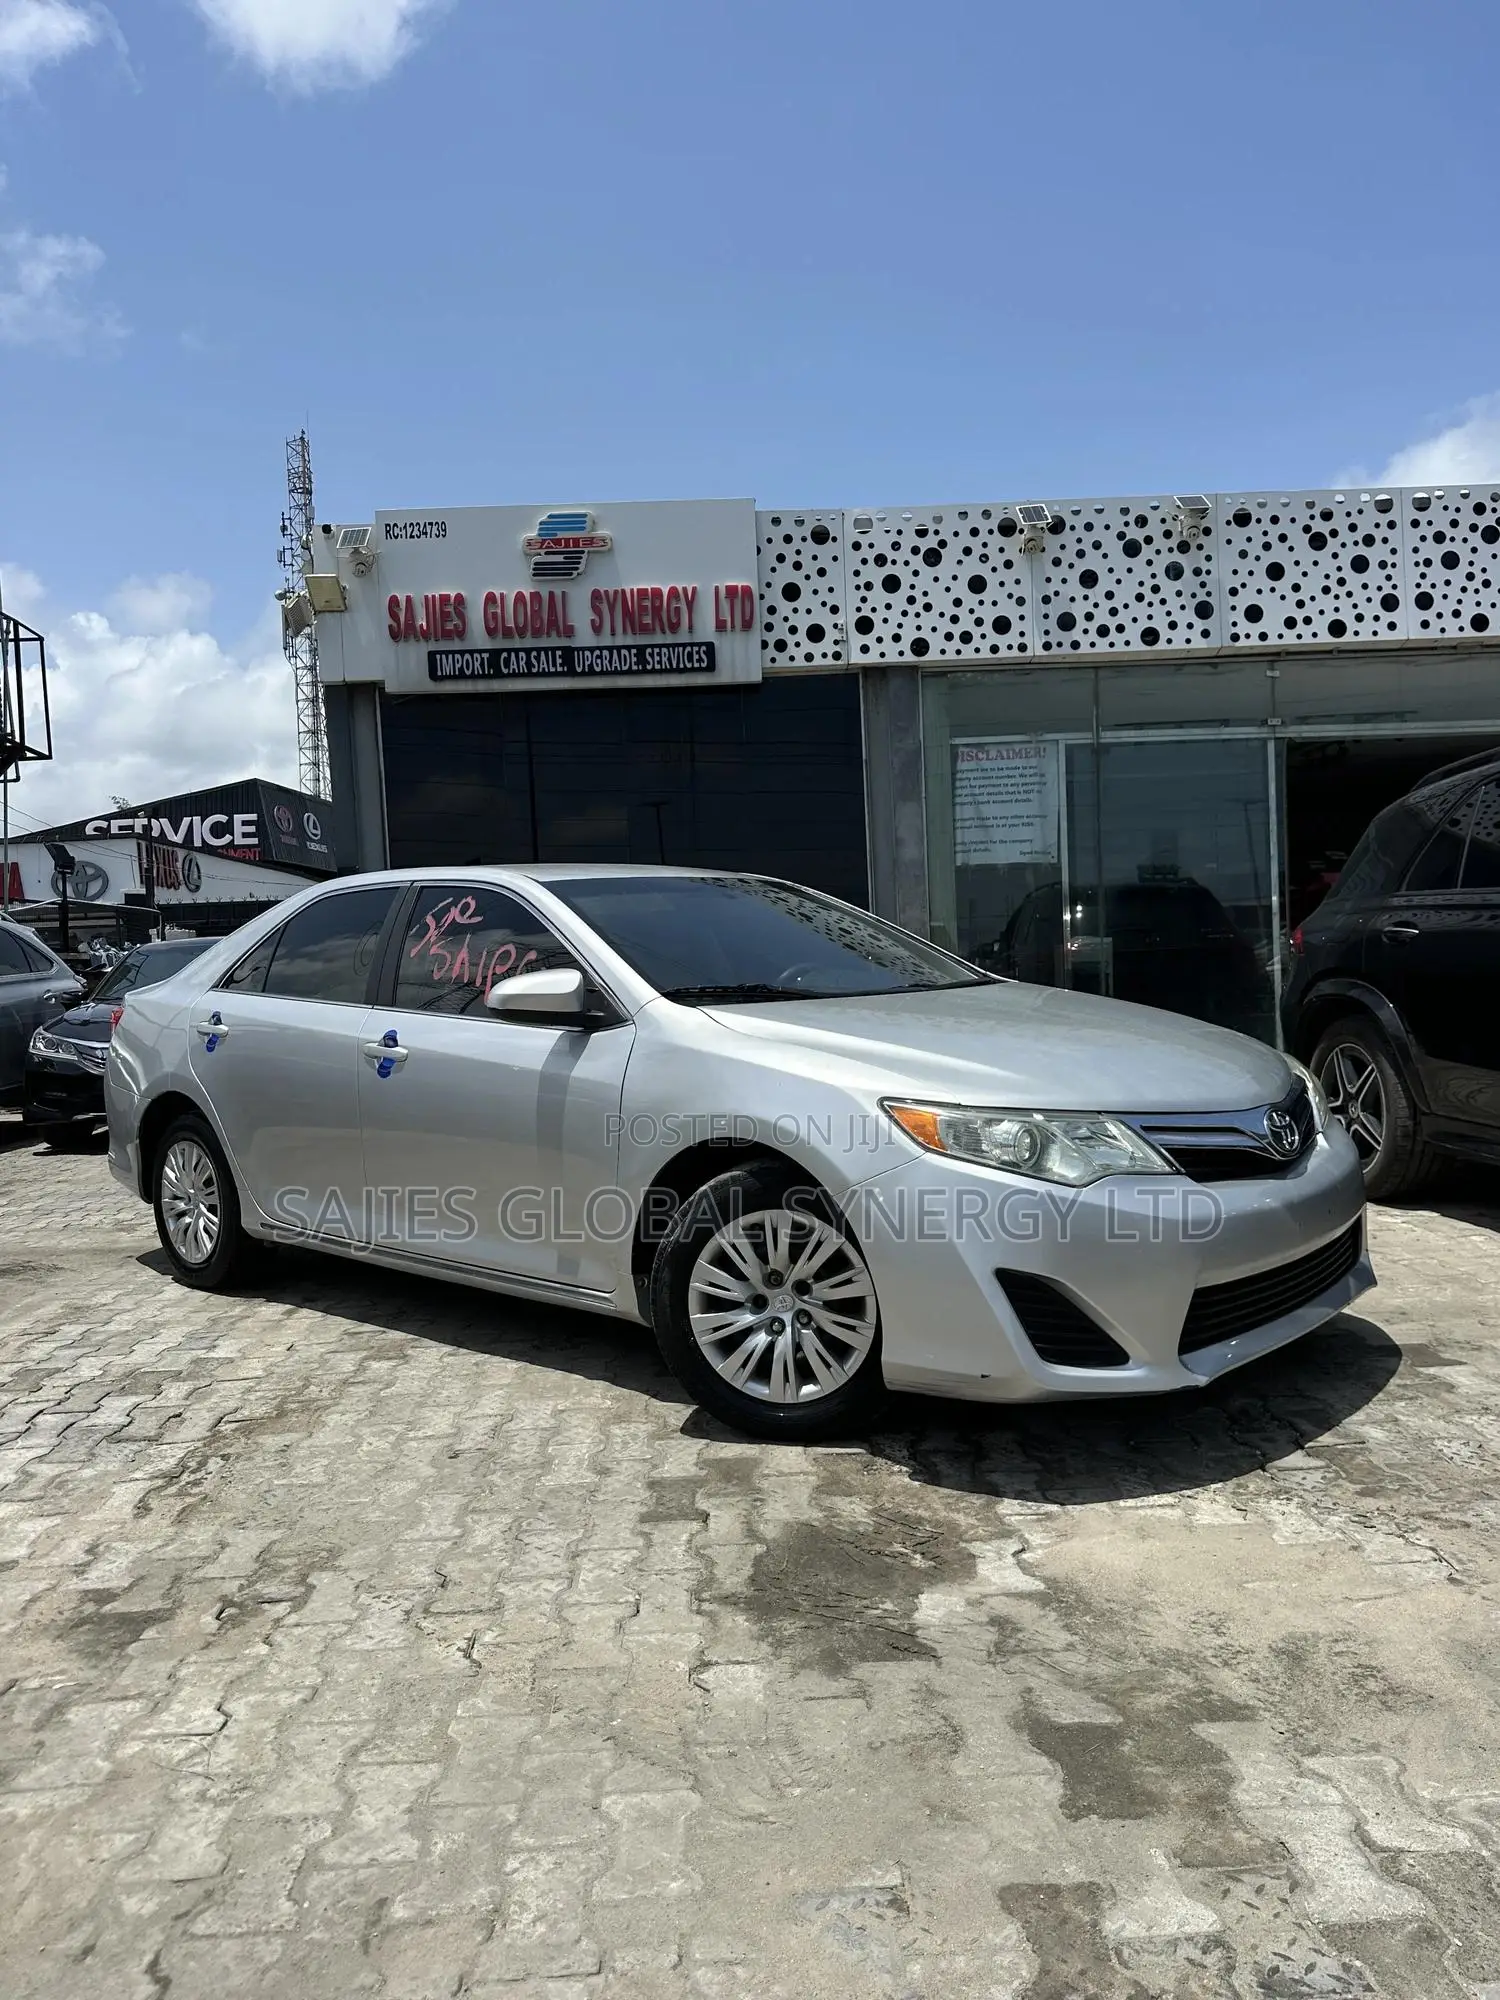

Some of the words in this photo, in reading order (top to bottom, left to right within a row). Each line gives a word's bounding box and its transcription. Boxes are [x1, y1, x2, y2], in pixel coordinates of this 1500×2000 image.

[384, 520, 447, 540] RC:1234739
[526, 536, 608, 550] SAJIES
[387, 592, 467, 643] SAJIES
[483, 590, 575, 639] GLOBAL
[590, 585, 697, 637] SYNERGY
[714, 584, 754, 632] LTD
[436, 652, 493, 676] IMPORT.
[500, 651, 528, 673] CAR
[531, 650, 567, 673] SALE.
[574, 648, 642, 673] UPGRADE.
[646, 645, 708, 670] SERVICES
